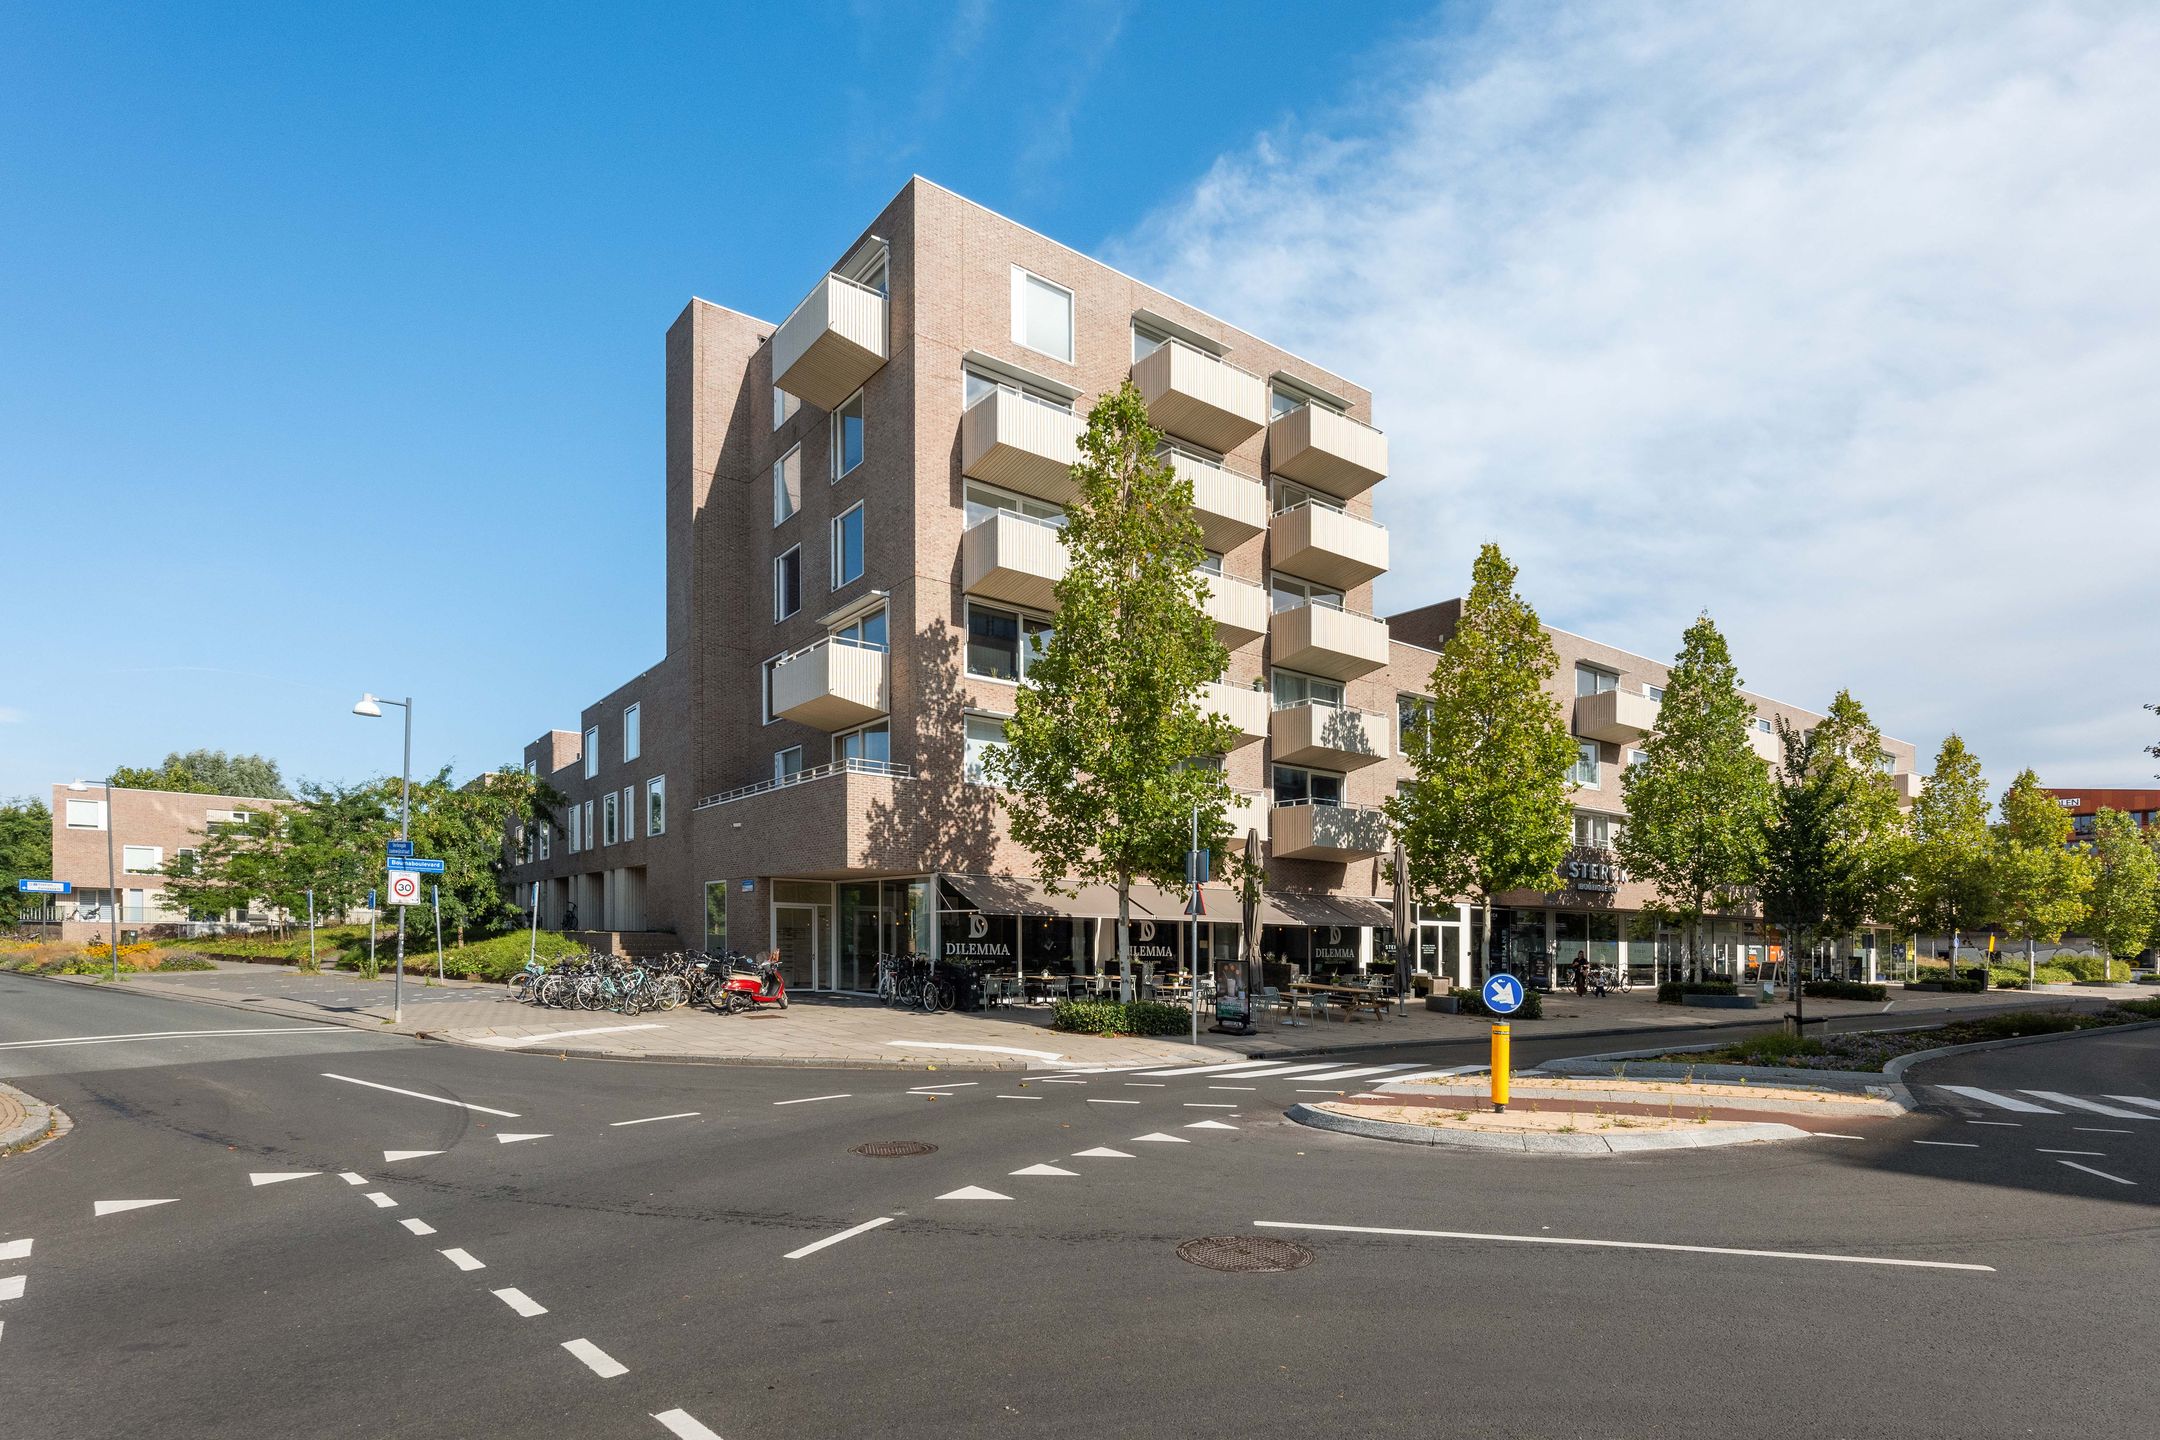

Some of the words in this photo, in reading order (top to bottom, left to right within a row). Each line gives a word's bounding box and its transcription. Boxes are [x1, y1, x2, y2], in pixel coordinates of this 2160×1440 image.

[1569, 861, 1628, 882] STERCK
[946, 943, 1010, 955] DILEMMA
[1129, 946, 1172, 956] ILEMMA
[1315, 948, 1355, 958] DILEMMA
